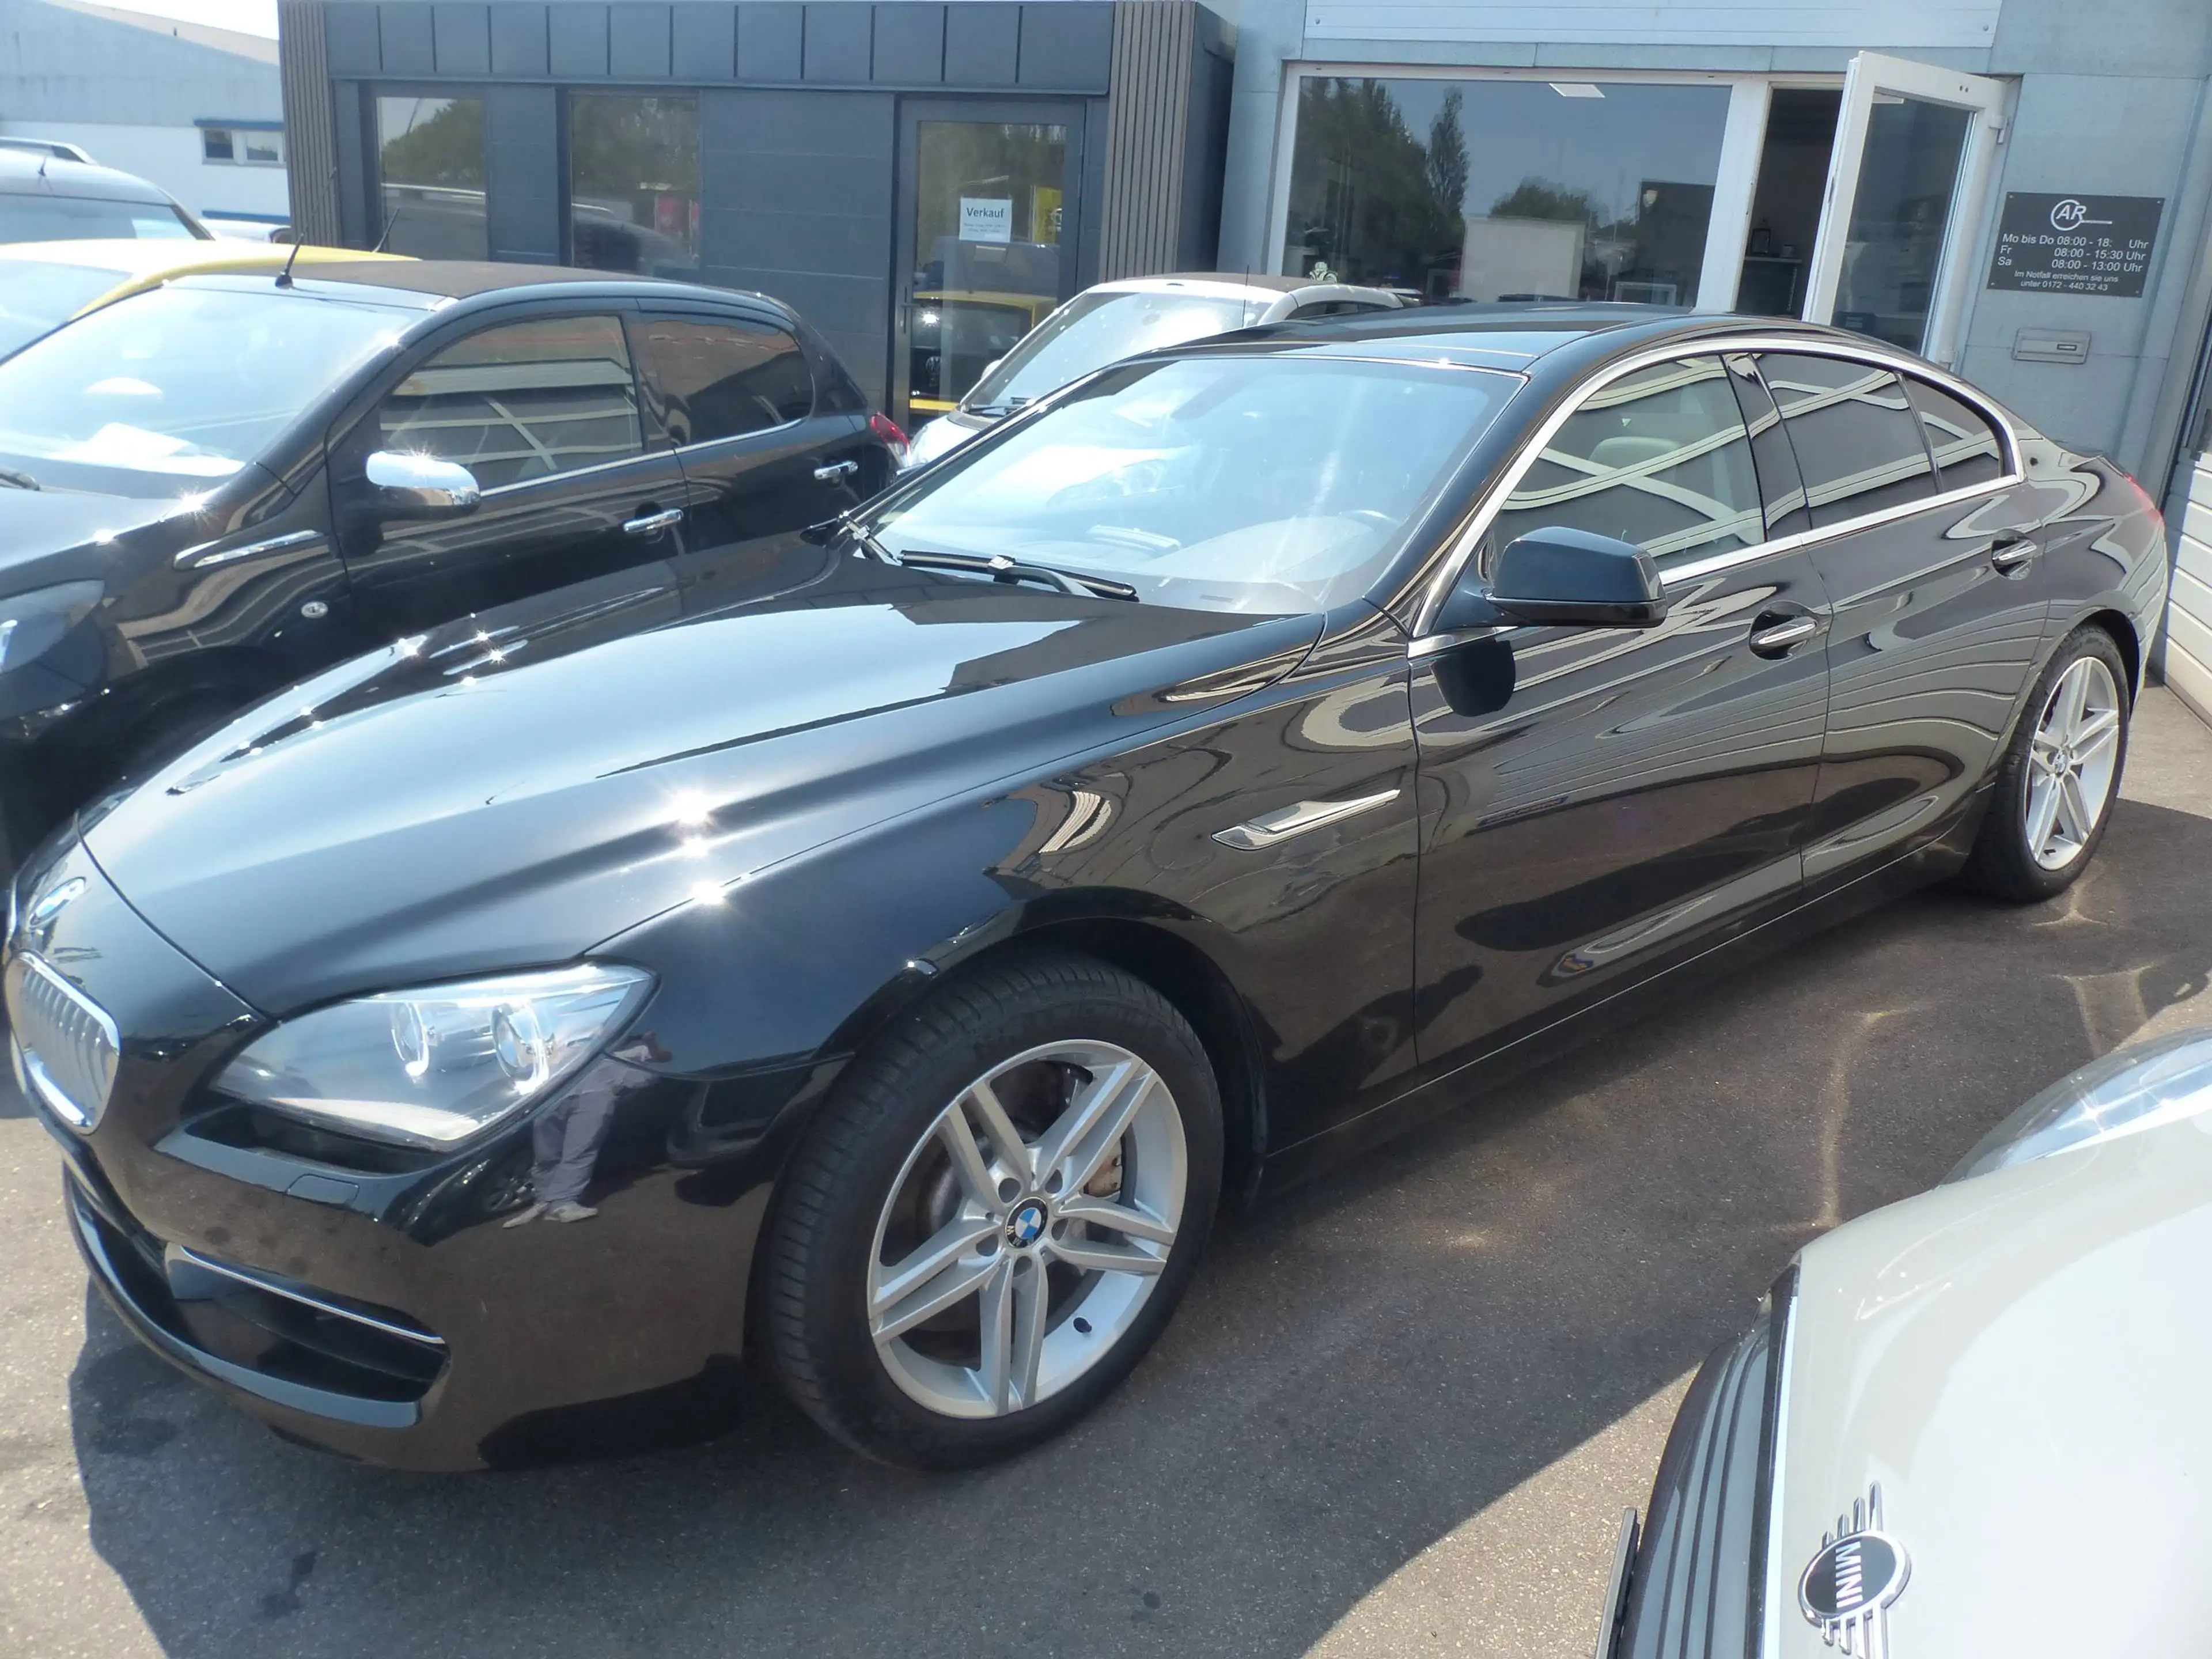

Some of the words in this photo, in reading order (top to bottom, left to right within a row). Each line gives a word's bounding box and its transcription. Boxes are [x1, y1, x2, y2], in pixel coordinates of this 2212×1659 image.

[966, 207, 1005, 218] Verkauf
[2002, 233, 2019, 243] Mo
[2021, 234, 2036, 243] bis
[2039, 235, 2054, 244] Do
[2057, 236, 2086, 246] 08:00
[2129, 239, 2149, 249] Uhr
[2000, 245, 2012, 254] Fr
[2054, 248, 2084, 257] 08:00
[2095, 249, 2123, 259] 15:30
[2126, 251, 2146, 260] Uhr
[1998, 256, 2012, 266] Sa
[2052, 259, 2081, 269] 08:00
[2092, 261, 2120, 271] 13:00
[2123, 263, 2143, 272] Uhr
[2026, 270, 2051, 278] Notfall
[2052, 272, 2088, 281] erreichen
[2043, 281, 2062, 289] 0172
[1835, 1540, 1863, 1609] MINI
